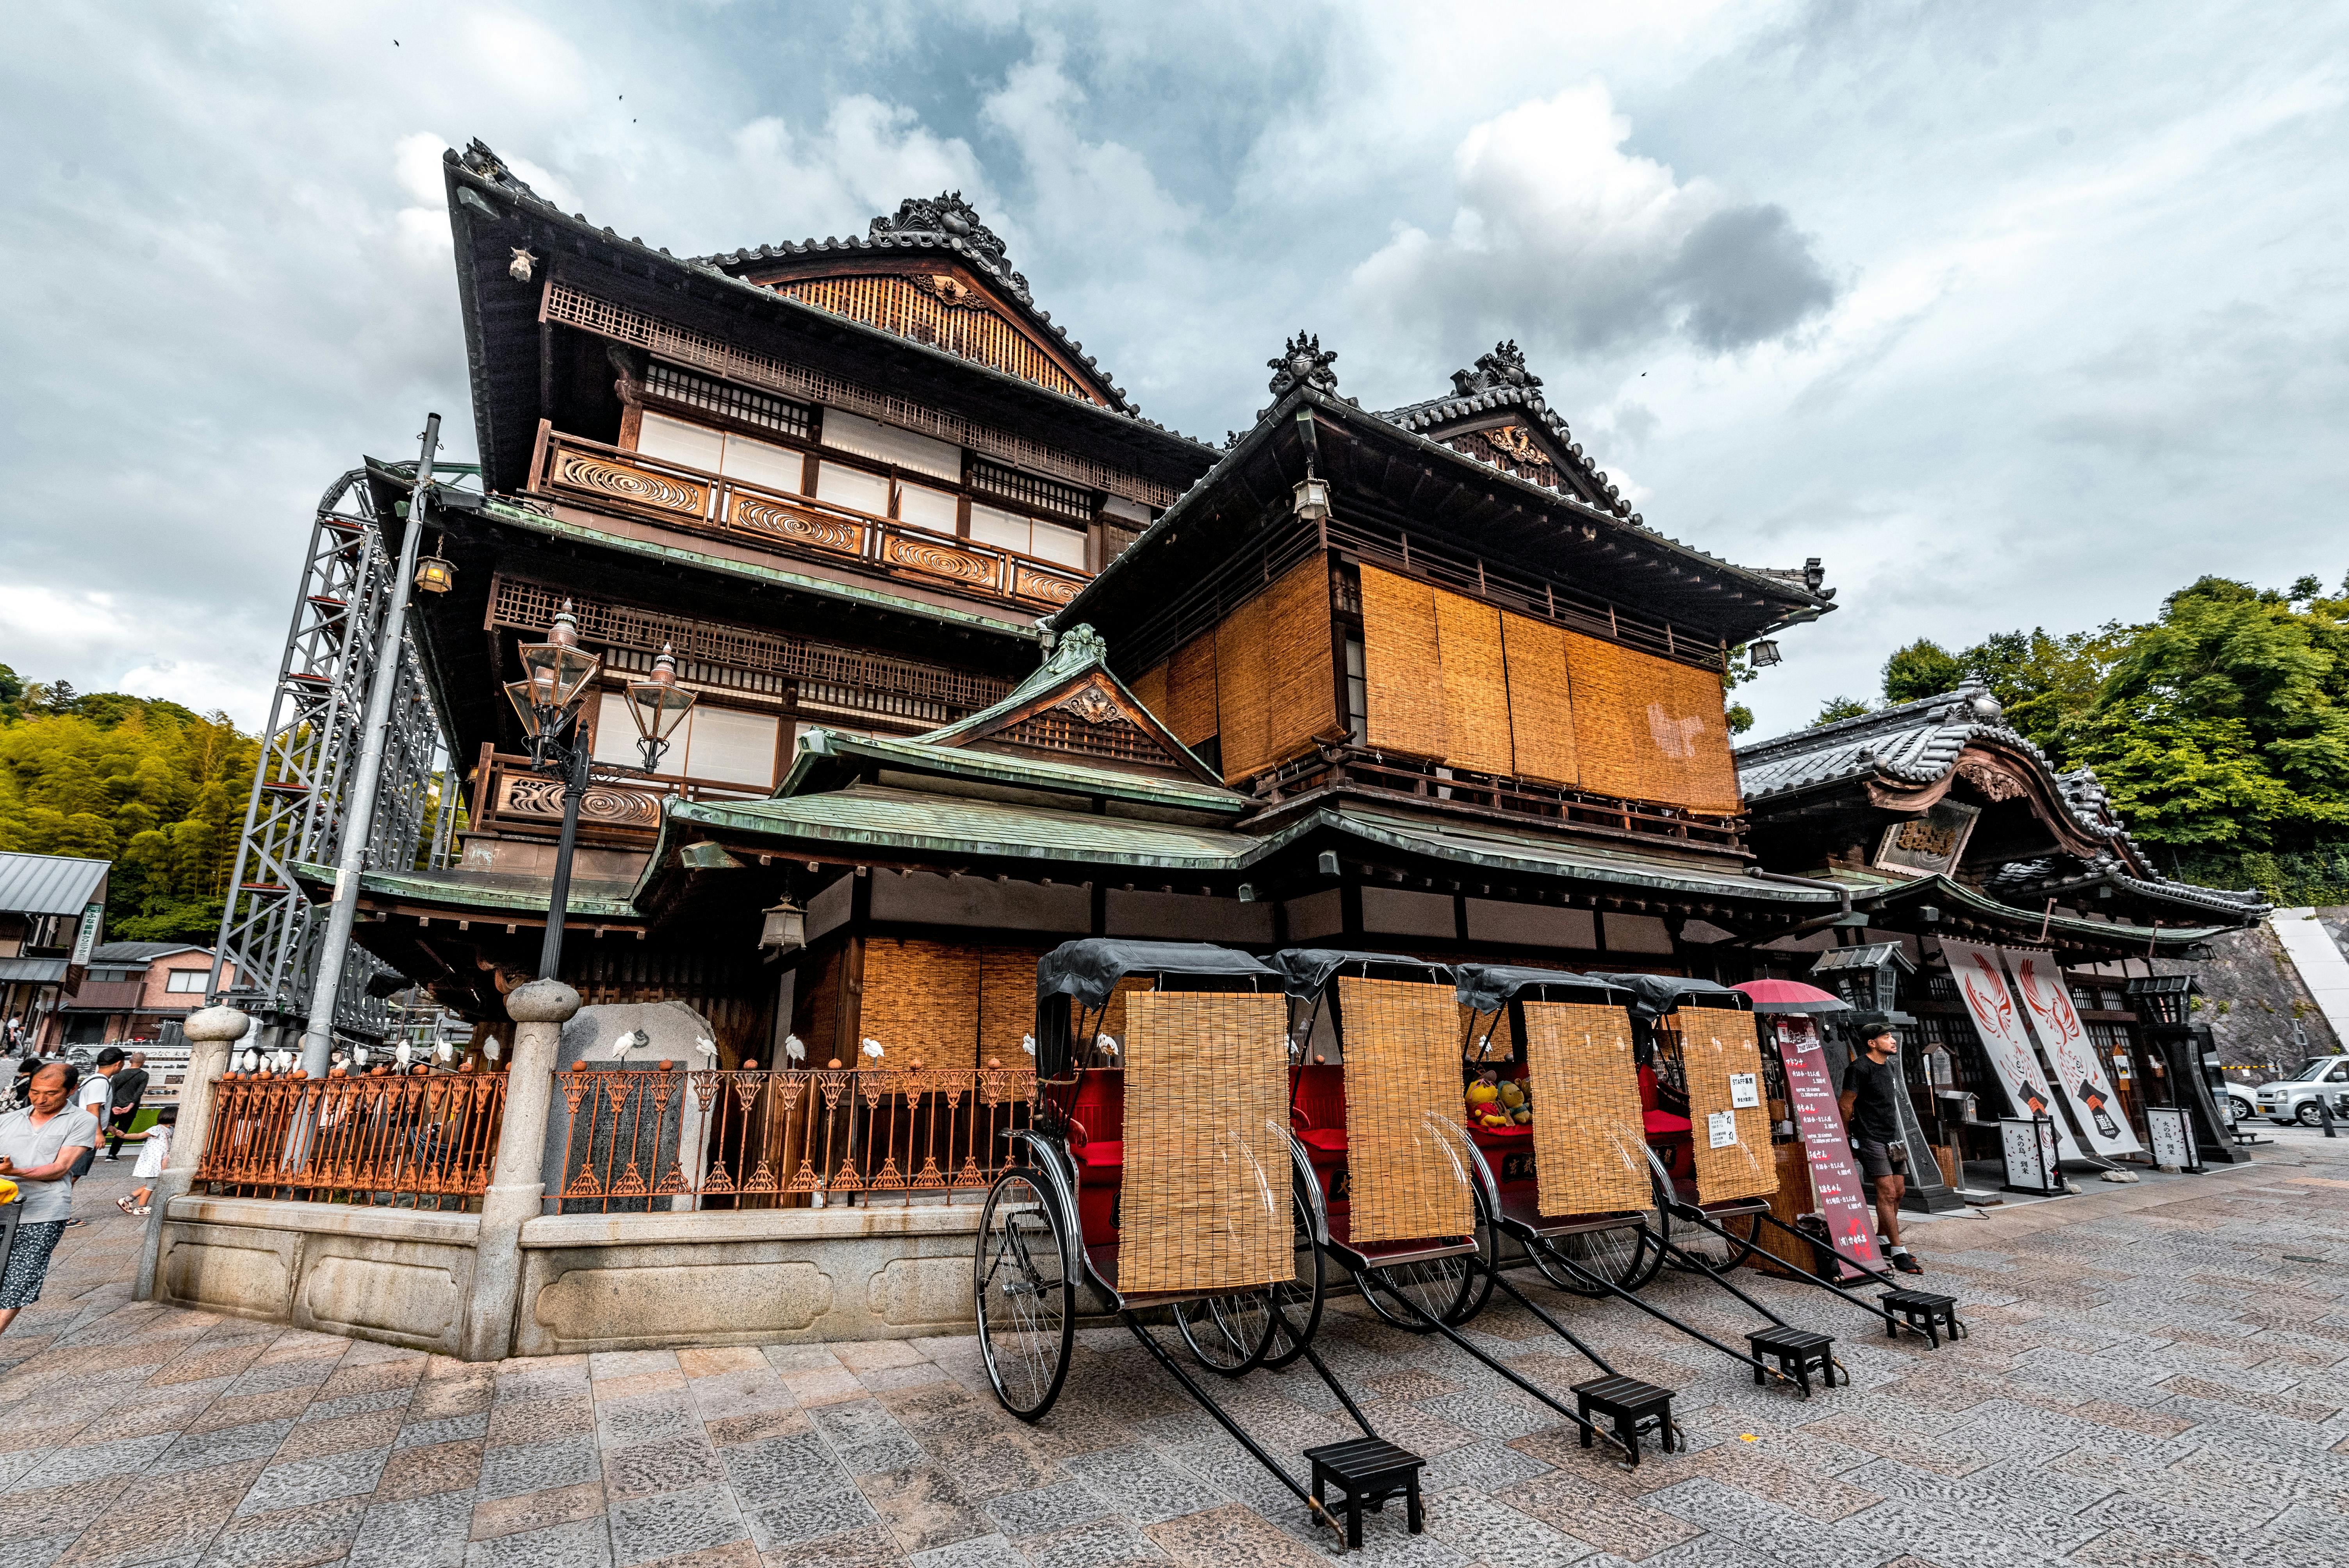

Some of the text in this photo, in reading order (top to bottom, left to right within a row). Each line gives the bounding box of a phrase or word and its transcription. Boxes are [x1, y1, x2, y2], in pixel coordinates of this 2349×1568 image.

[2017, 1134, 2029, 1174] 火の鳥、到来
